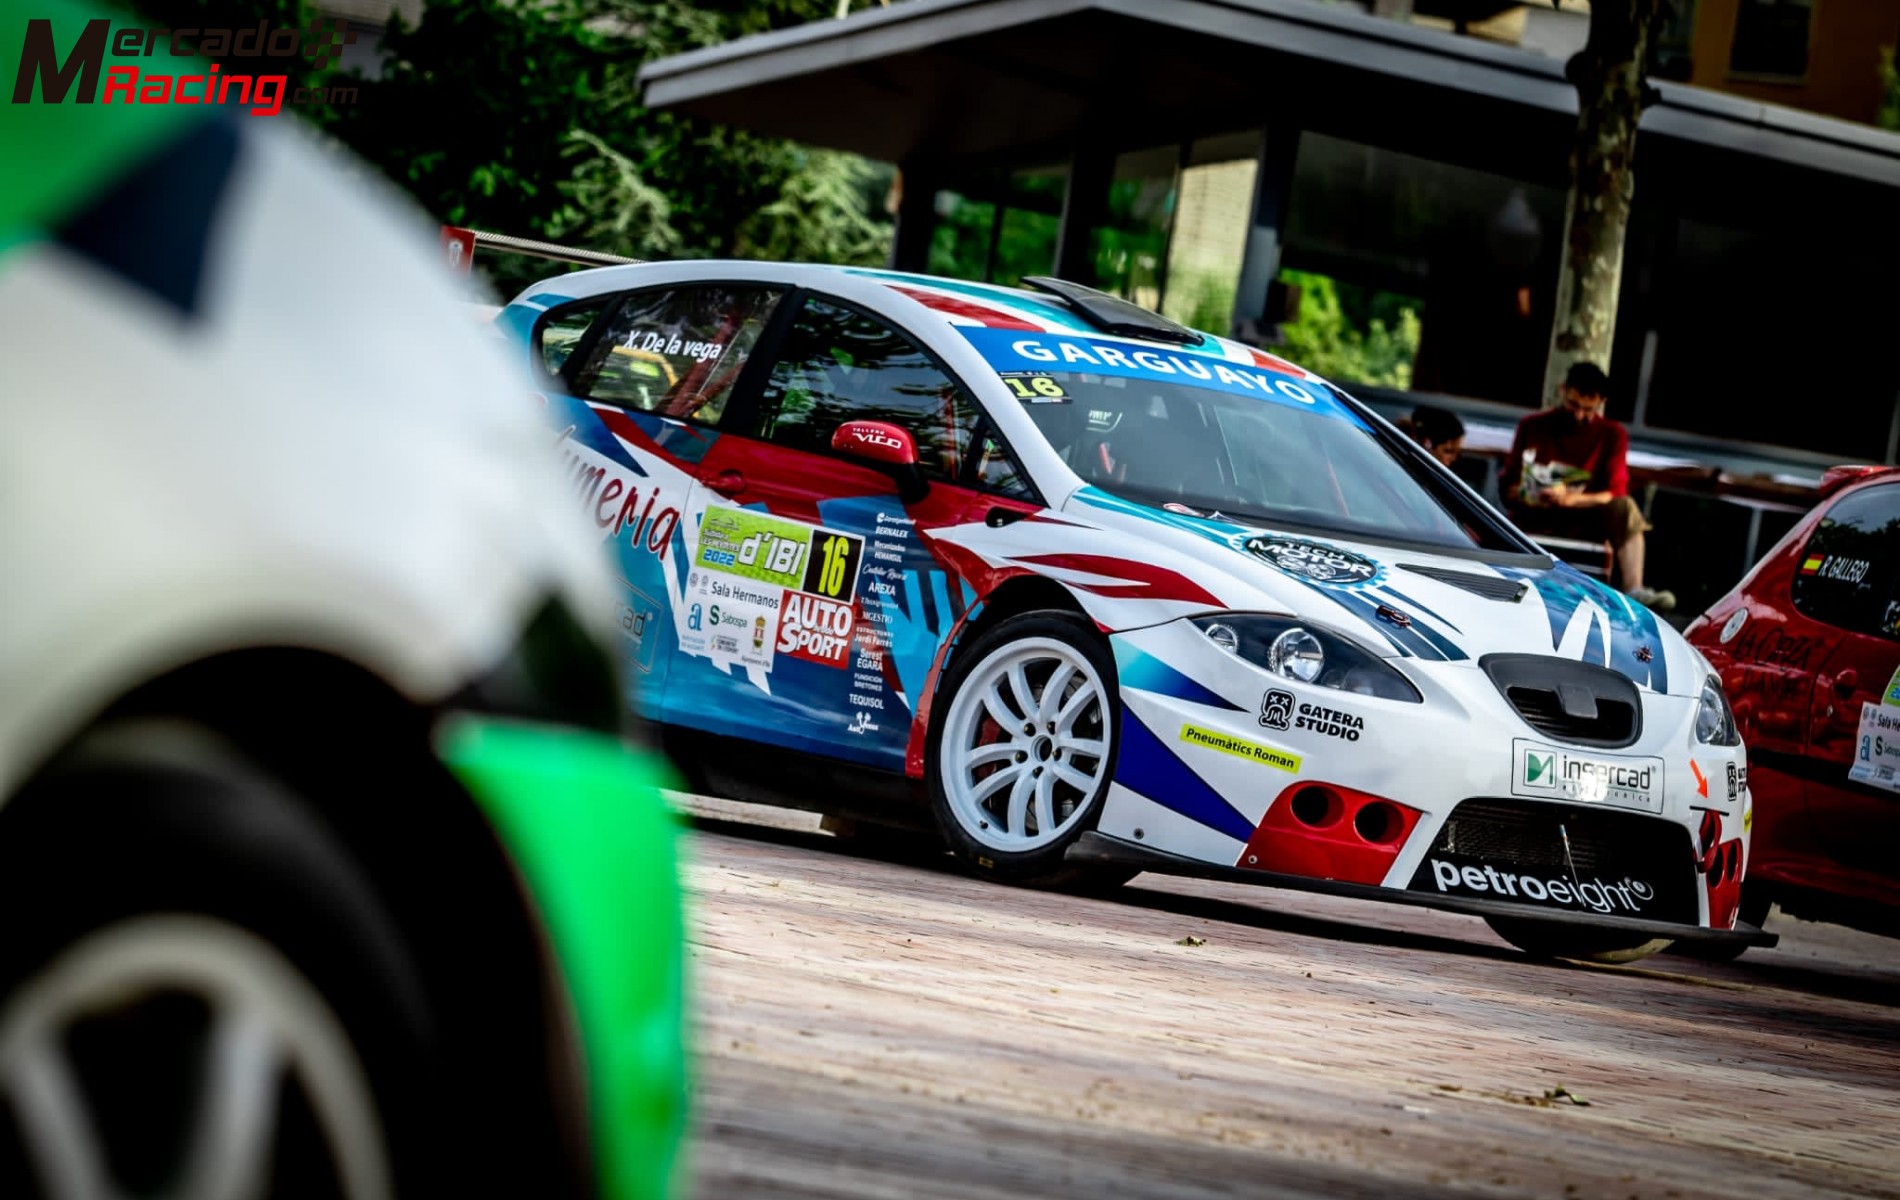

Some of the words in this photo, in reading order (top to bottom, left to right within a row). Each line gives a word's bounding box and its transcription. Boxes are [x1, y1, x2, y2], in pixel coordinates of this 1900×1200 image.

[623, 330, 640, 349] X.
[641, 332, 665, 353] De
[664, 333, 682, 355] la
[682, 341, 722, 363] vega
[1012, 340, 1316, 405] GARGUAYO
[1004, 377, 1064, 397] 16
[703, 548, 735, 566] 2022
[1248, 539, 1372, 578] MOTOR
[1285, 541, 1345, 561] TECH
[818, 535, 849, 597] 16
[711, 581, 730, 597] Sala
[732, 586, 779, 609] Hermanos
[868, 582, 896, 597] AREXA
[782, 594, 853, 637] AUTO
[777, 622, 848, 660] SPORT
[857, 658, 883, 671] EGARA
[849, 693, 884, 710] TEQUISOL
[1295, 716, 1360, 742] STUDIO
[1299, 703, 1365, 730] GATERA
[1253, 748, 1294, 768] Roman
[1431, 858, 1641, 913] petroeight
